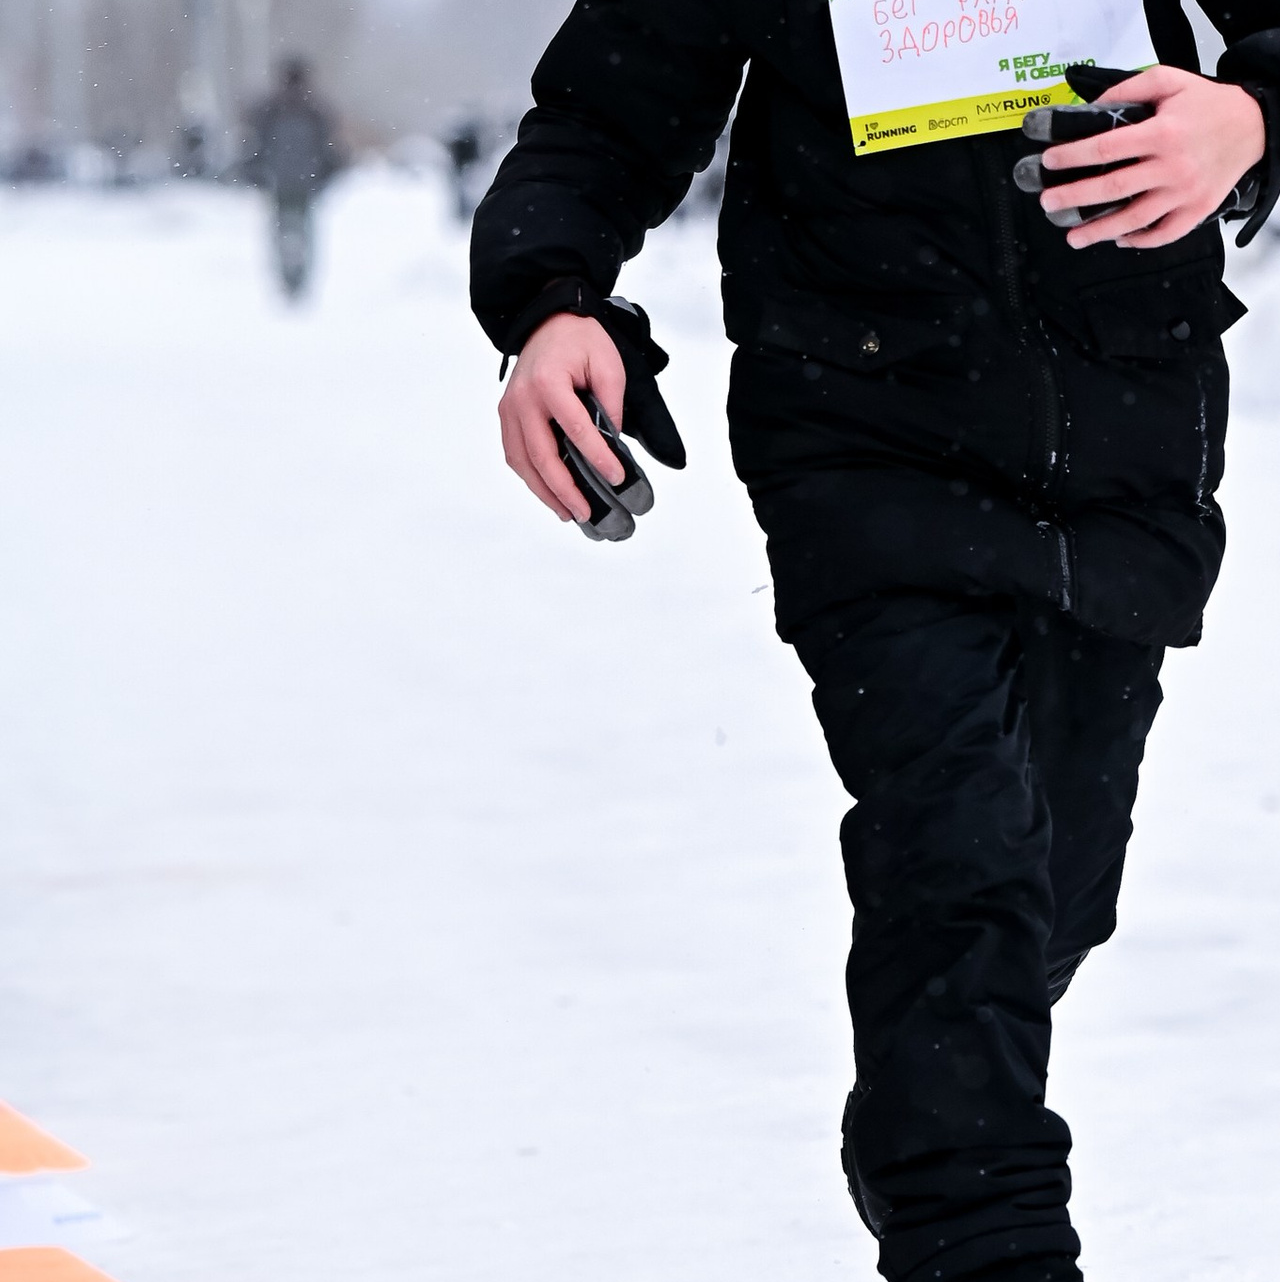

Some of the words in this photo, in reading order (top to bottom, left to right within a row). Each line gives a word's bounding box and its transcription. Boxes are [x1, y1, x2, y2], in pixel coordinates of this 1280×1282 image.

[879, 6, 1019, 64] ЗДОРОВЬЯ
[999, 58, 1010, 72] Я
[1013, 52, 1051, 68] БЕГУ
[1015, 69, 1027, 83] И
[864, 123, 869, 132] I
[866, 125, 917, 142] RUNNING
